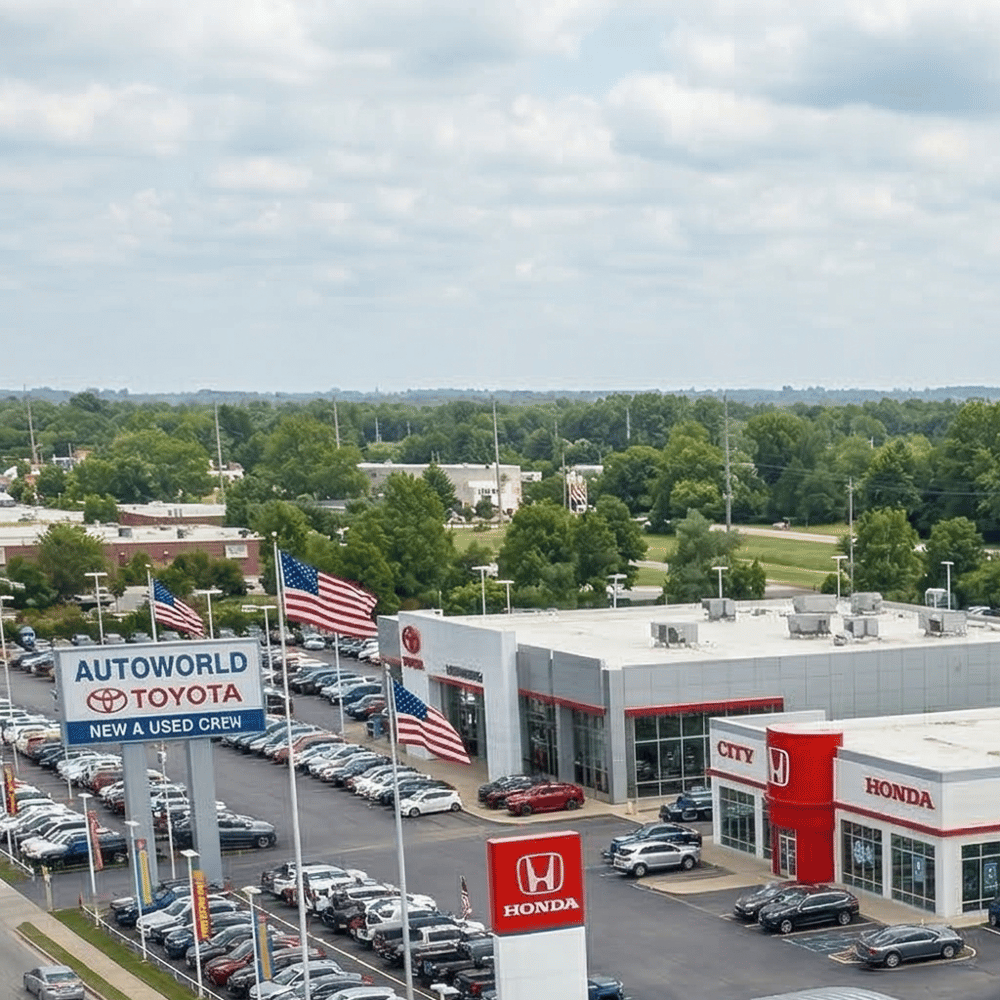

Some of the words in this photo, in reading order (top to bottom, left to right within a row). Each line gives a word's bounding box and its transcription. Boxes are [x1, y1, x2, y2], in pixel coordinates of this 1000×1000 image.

[75, 651, 248, 683] AUTOWORLD
[131, 683, 243, 708] TOYOTA
[90, 724, 128, 739] NEW
[149, 719, 195, 734] USED
[199, 716, 242, 731] CREW
[717, 740, 754, 764] CITY
[865, 776, 935, 810] HONDA
[503, 897, 579, 917] HONDA
